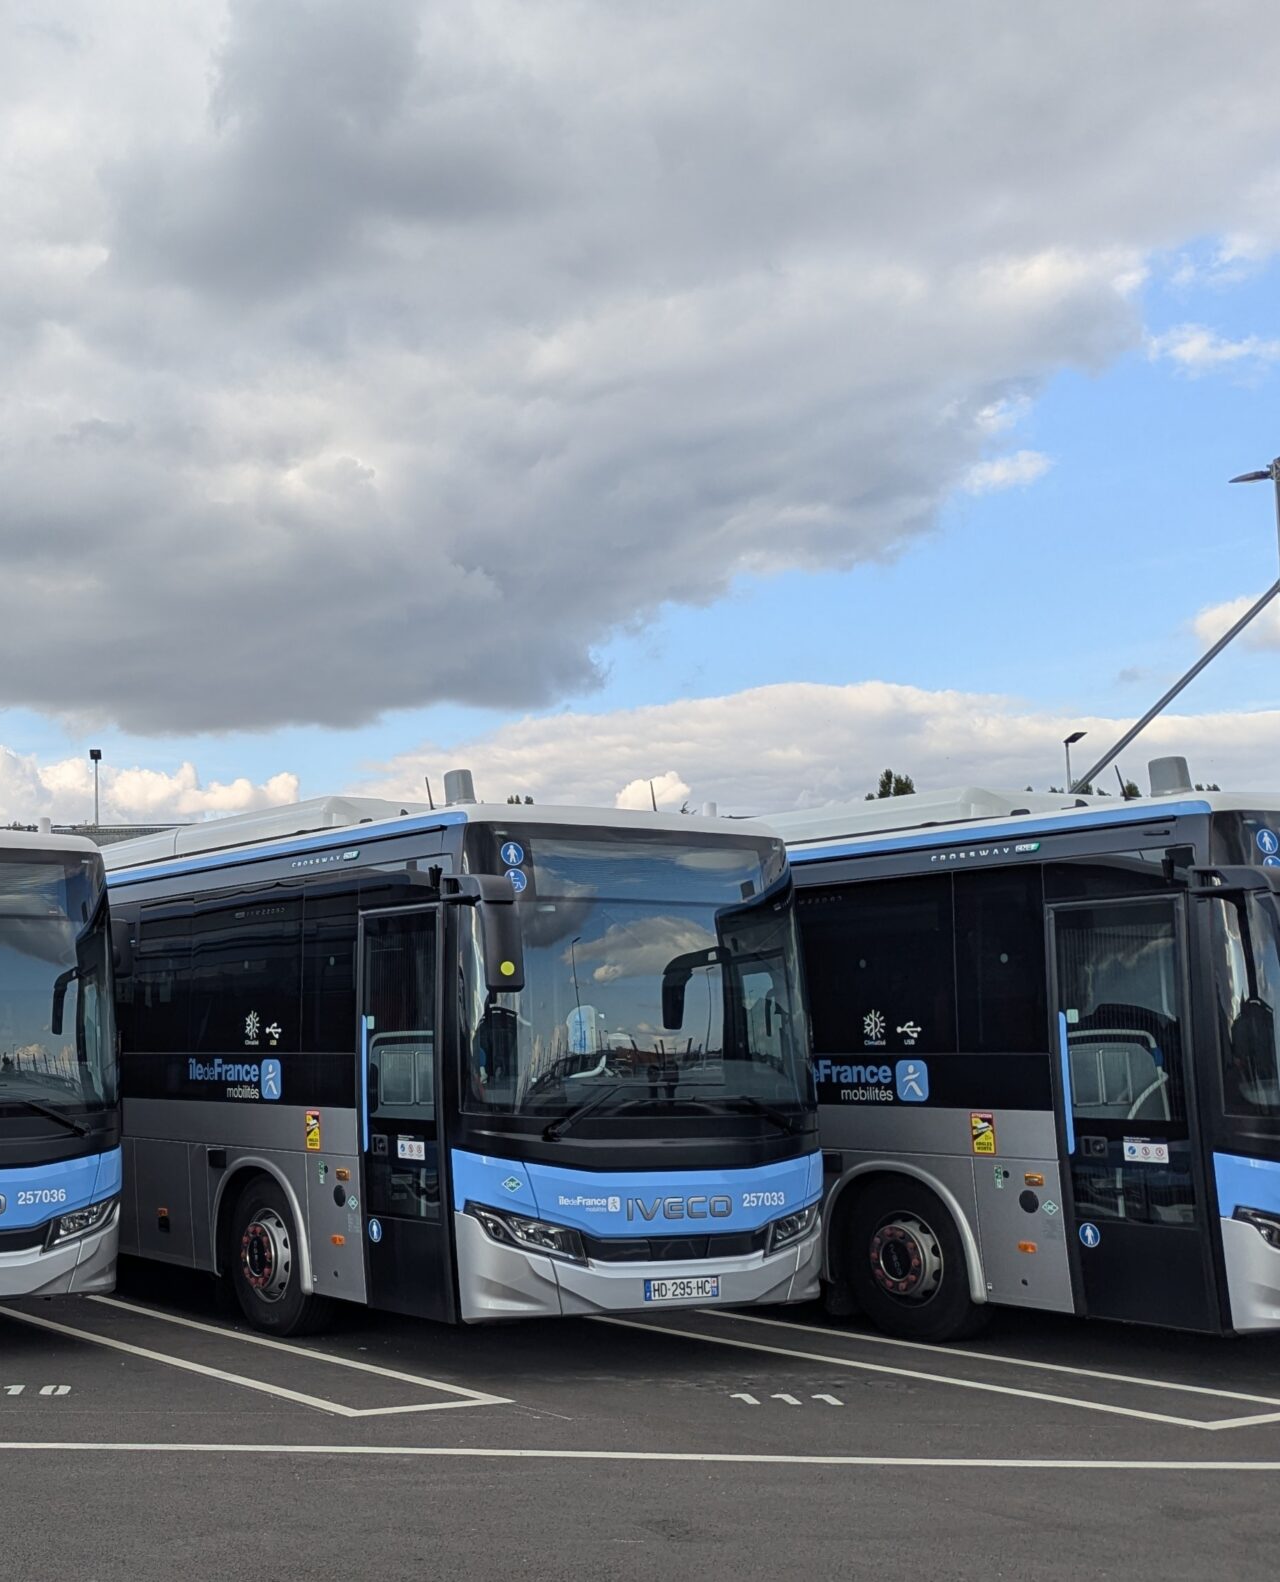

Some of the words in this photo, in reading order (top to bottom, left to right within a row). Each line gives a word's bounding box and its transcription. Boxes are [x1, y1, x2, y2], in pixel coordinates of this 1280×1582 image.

[291, 855, 341, 868] CROSSWAY
[930, 847, 1010, 862] CROSSWAY
[226, 1085, 260, 1099] mobilités
[840, 1086, 894, 1101] mobilités
[17, 1188, 67, 1205] 257036
[742, 1191, 785, 1207] 257033
[626, 1195, 733, 1222] IVECO
[652, 1280, 710, 1298] HD-295-HC
[729, 1393, 845, 1405] 111
